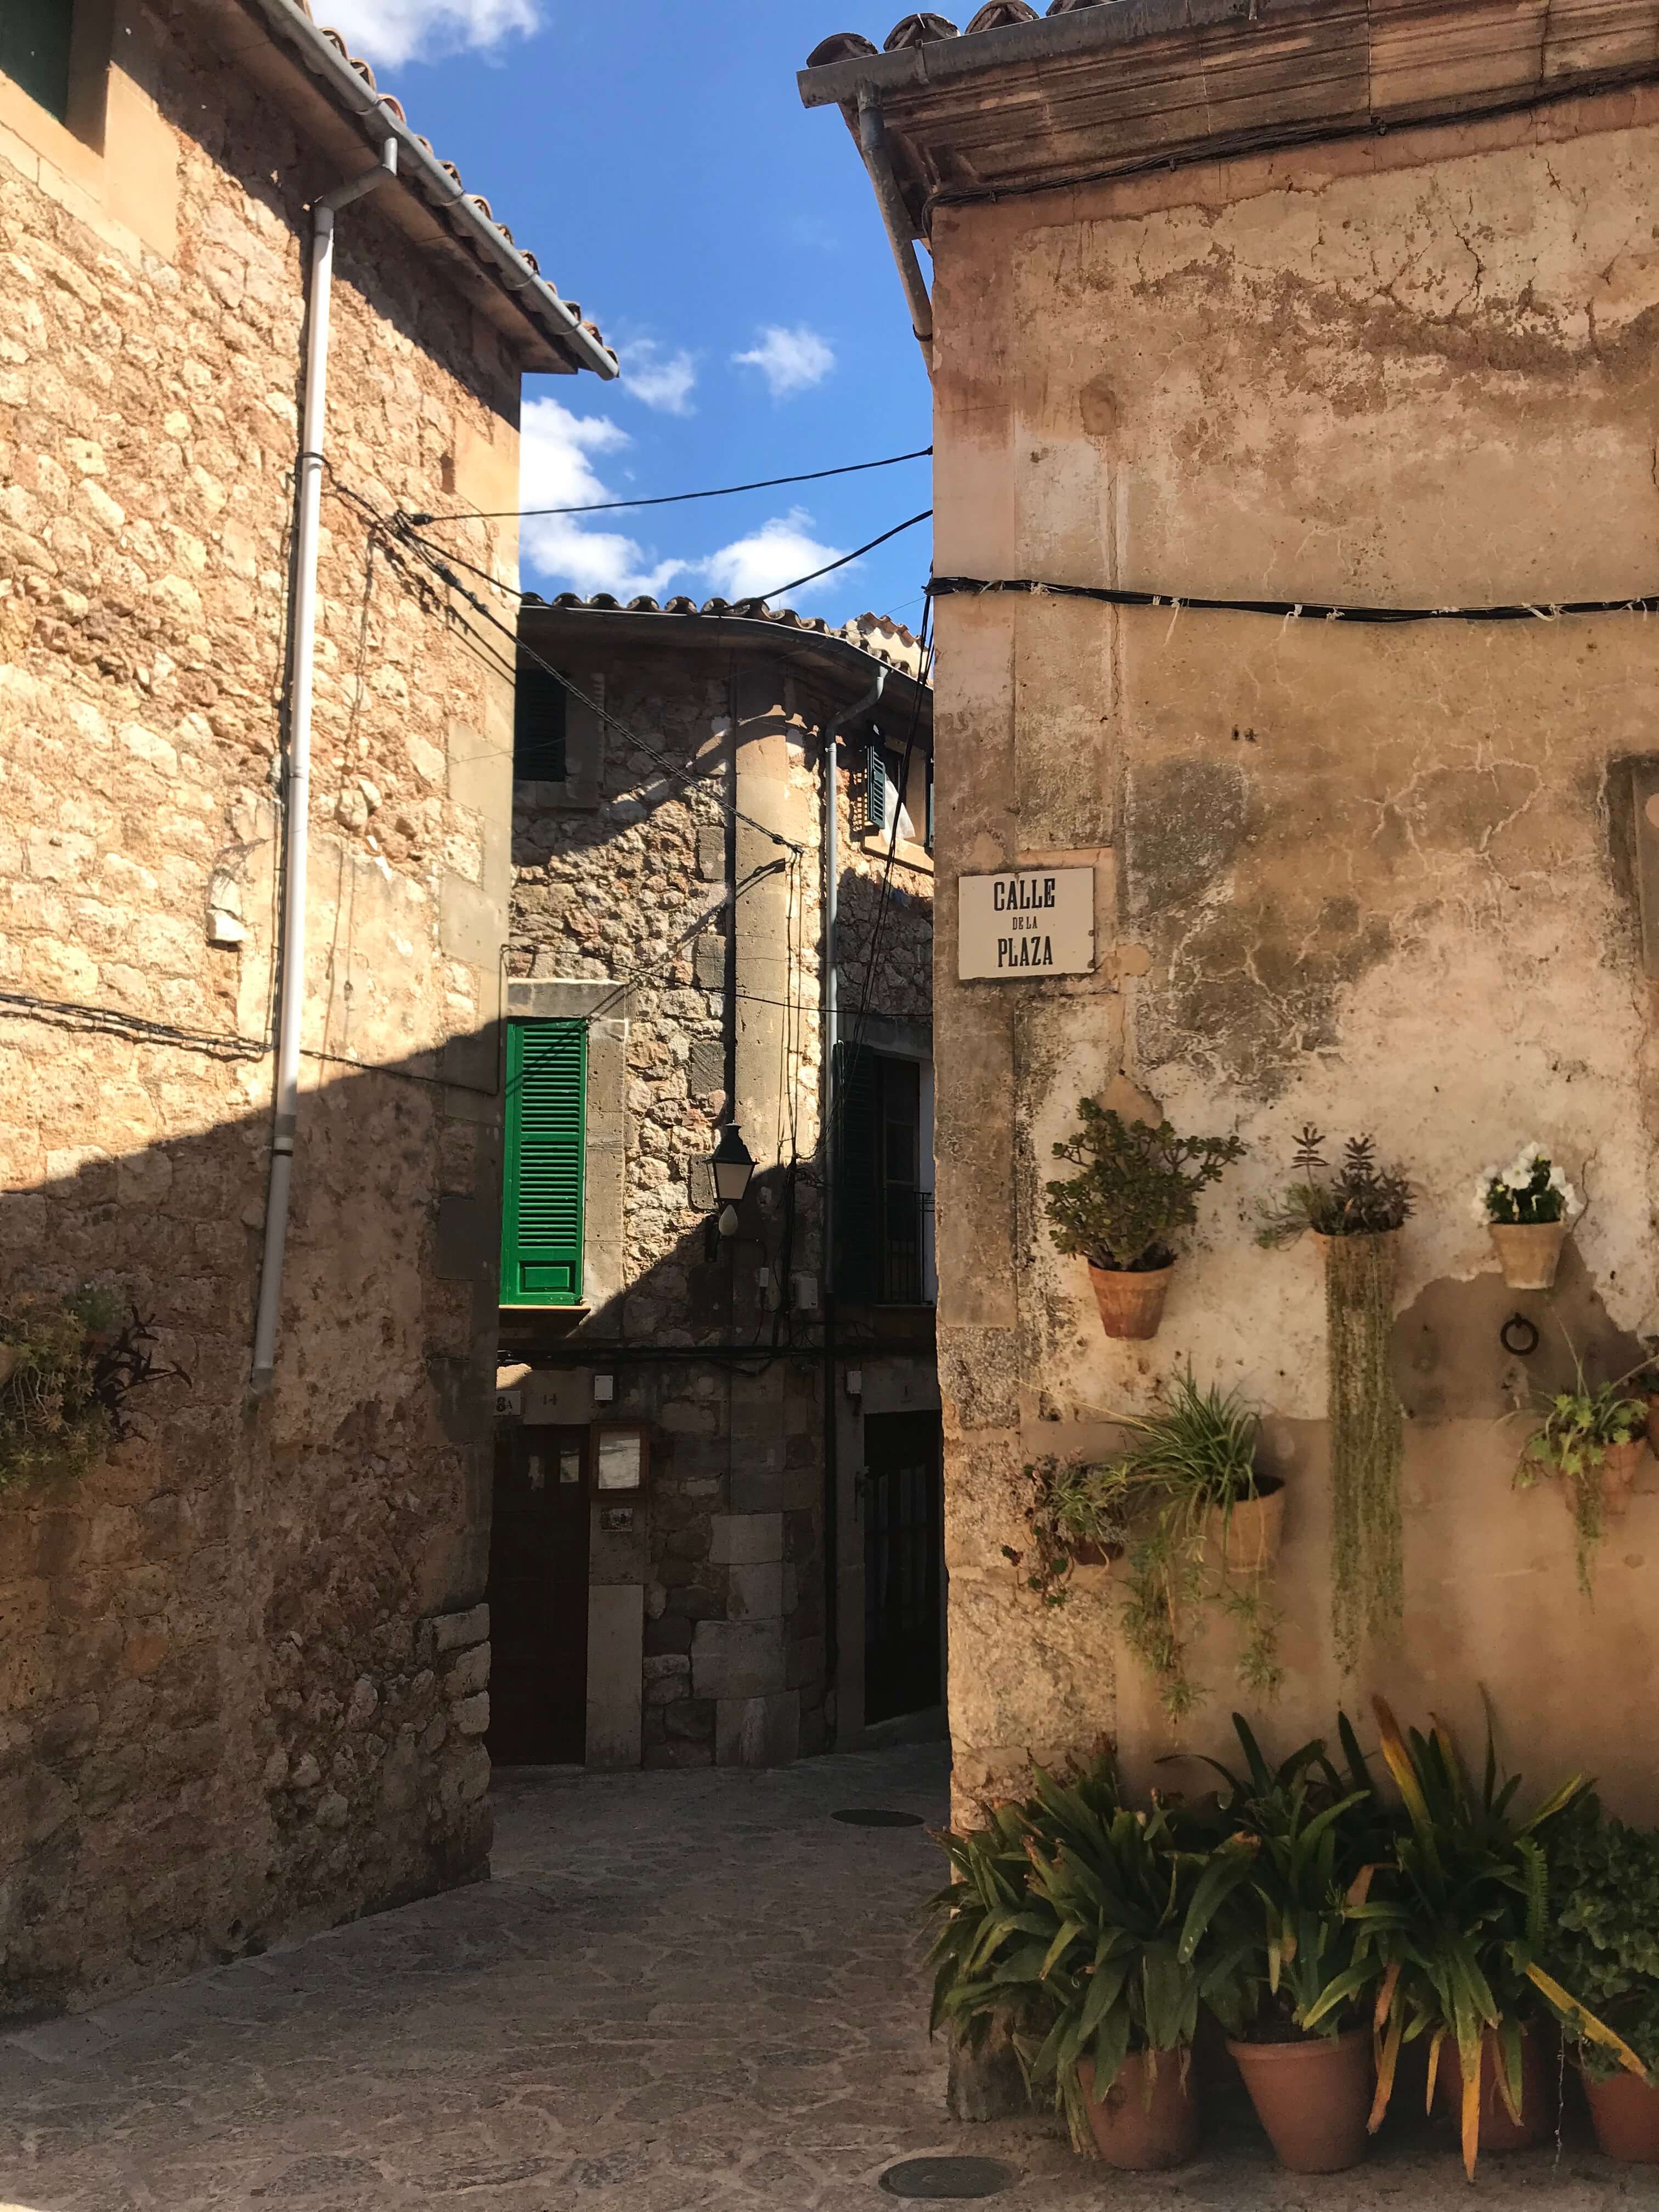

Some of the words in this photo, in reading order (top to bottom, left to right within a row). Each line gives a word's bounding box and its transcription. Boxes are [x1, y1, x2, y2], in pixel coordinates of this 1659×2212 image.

[994, 878, 1056, 911] CALLE
[1012, 917, 1024, 930] DE
[1025, 916, 1038, 929] LA
[997, 935, 1053, 968] PLAZA
